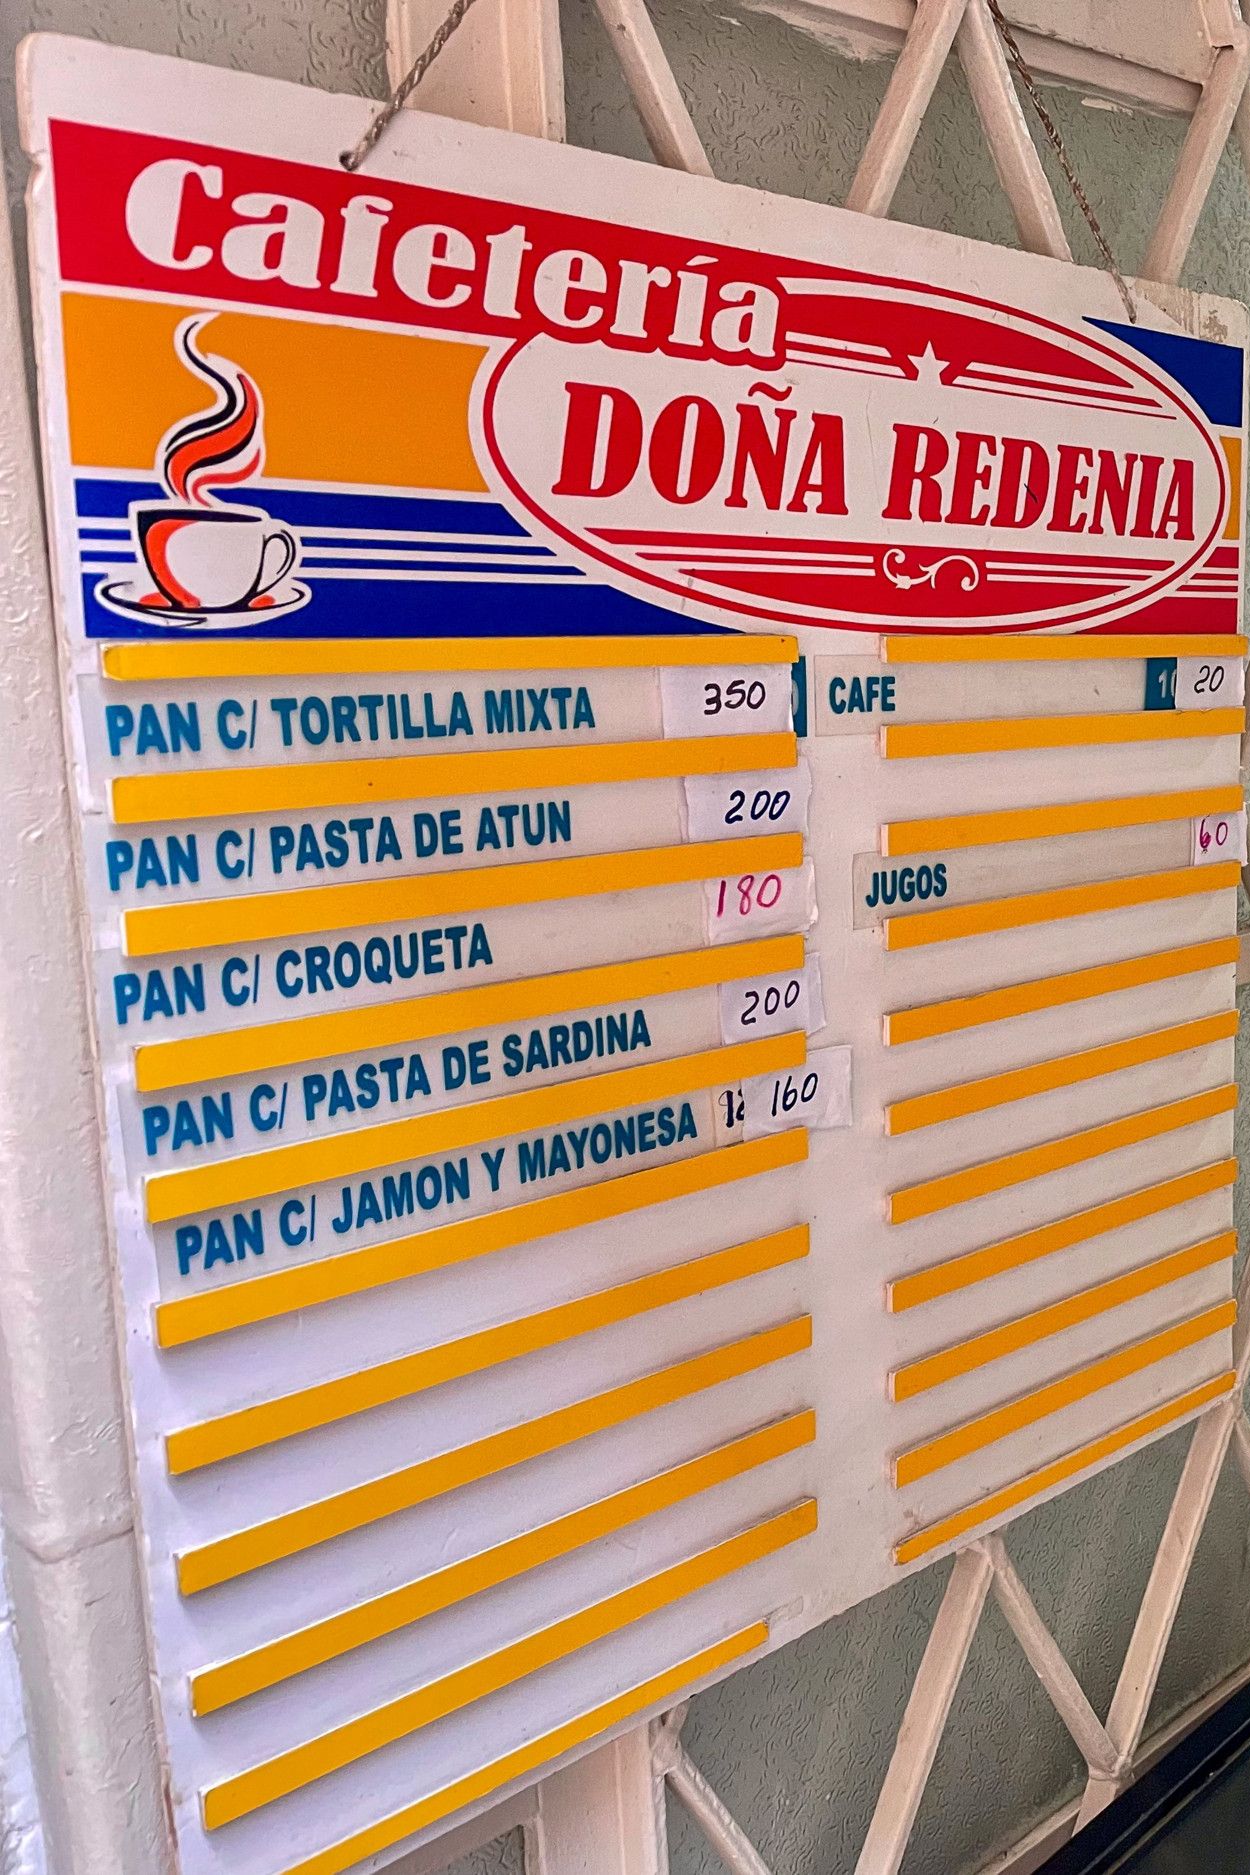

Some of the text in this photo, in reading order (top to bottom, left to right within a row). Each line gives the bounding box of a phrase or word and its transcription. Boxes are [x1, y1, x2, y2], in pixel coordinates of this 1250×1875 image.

[126, 159, 779, 358] Cafetería
[551, 381, 1195, 541] DOÑA REDENIA
[703, 679, 766, 716] 350
[829, 676, 896, 714] CAFE
[1194, 665, 1225, 694] 20
[105, 687, 595, 757] PAN C/ TORTILLA MIXTA
[724, 789, 791, 825] 200
[105, 801, 571, 892] PAN C/ PASTA DE ATUN
[1199, 814, 1229, 850] 60
[716, 873, 782, 918] 180
[866, 863, 947, 907] JUGOS
[113, 923, 493, 1025] PAN C/ CROQUETA
[740, 980, 800, 1026] 200
[142, 1009, 651, 1157] PAN C/ PASTA DE SARDINA
[771, 1072, 819, 1117] 160
[175, 1103, 697, 1276] PAN C/ JAMON Y MAYONESA
